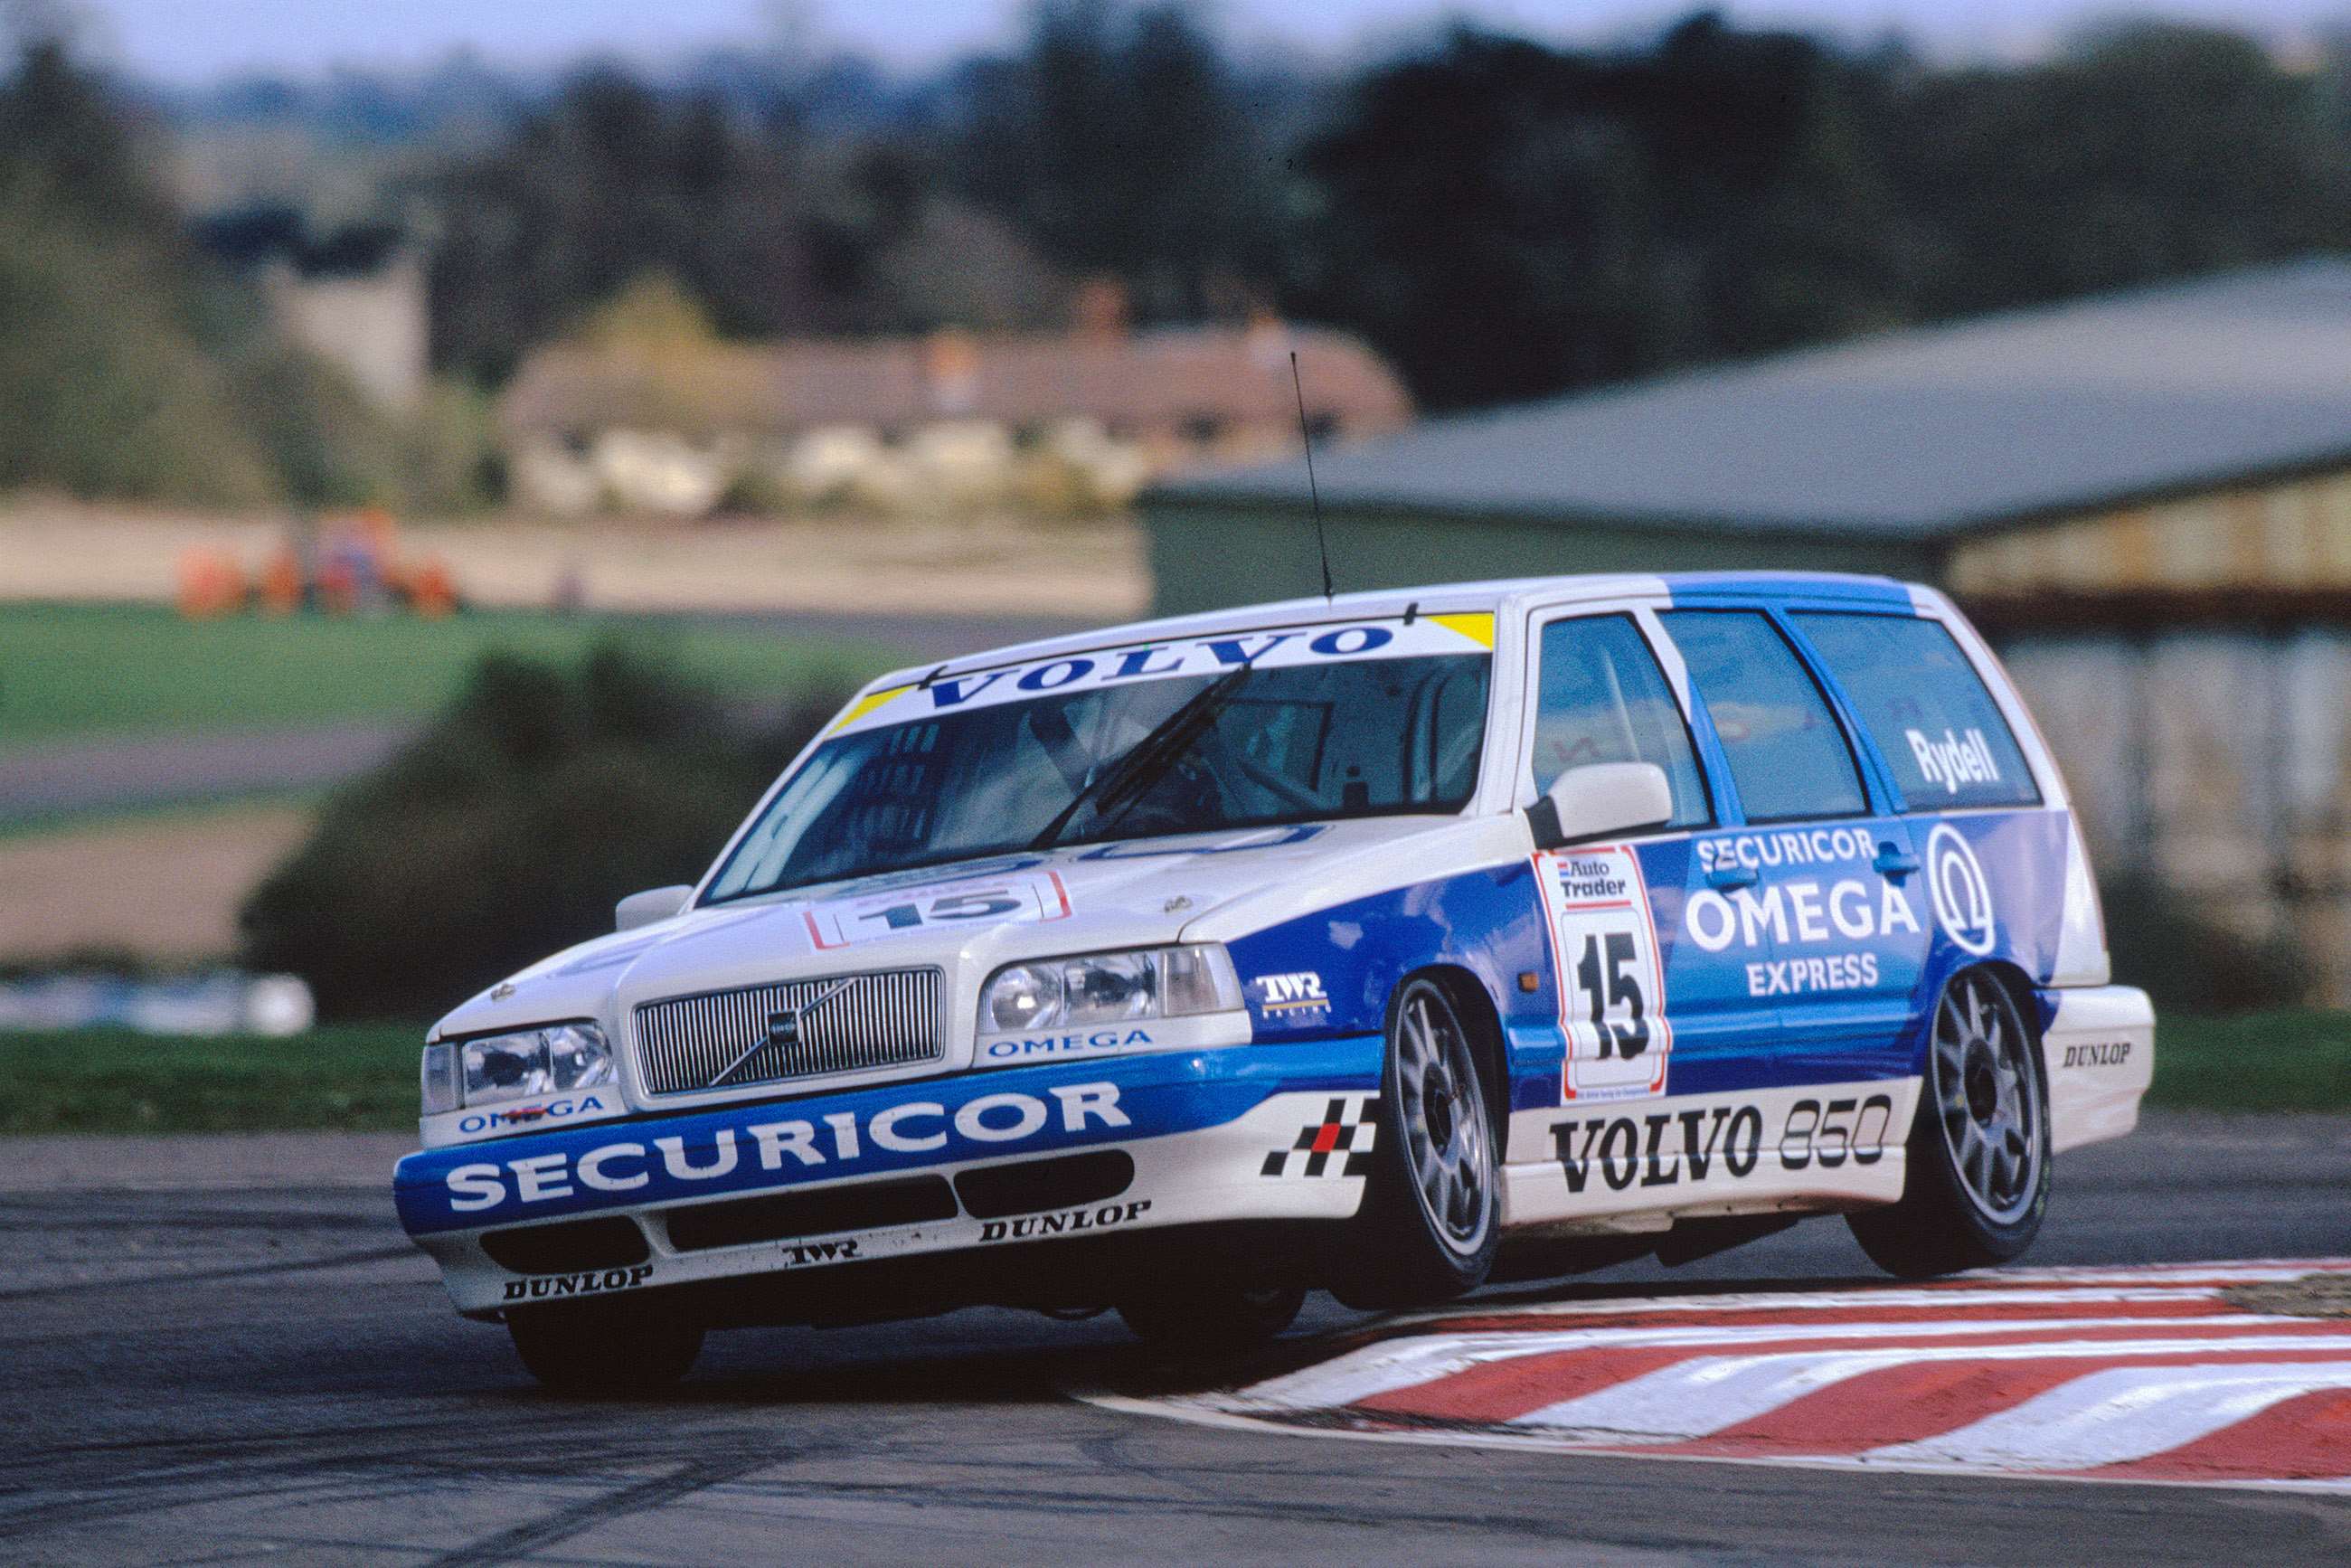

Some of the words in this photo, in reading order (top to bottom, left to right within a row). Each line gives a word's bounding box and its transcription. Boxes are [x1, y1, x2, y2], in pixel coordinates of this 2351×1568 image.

[930, 626, 1393, 709] VOLVO
[1905, 727, 2000, 795] Rydell
[1570, 860, 1610, 878] Auto
[1696, 827, 1879, 874] SECURICOR
[858, 889, 1023, 930] 15
[1561, 878, 1626, 898] Trader
[1685, 878, 1921, 952] OMEGA
[1255, 970, 1327, 1004] TWR
[1745, 951, 1879, 997] EXPRESS
[1577, 931, 1650, 1061] 15
[988, 1029, 1154, 1058] OMEGA
[2063, 1042, 2131, 1068] DUNLOP
[445, 1081, 1133, 1212] SECURICOR
[1549, 1104, 1763, 1194] VOLVO
[1778, 1093, 1893, 1170] 850
[979, 1199, 1153, 1242] DUNLOP
[782, 1238, 864, 1265] TWR
[503, 1264, 654, 1300] DUNLOP
